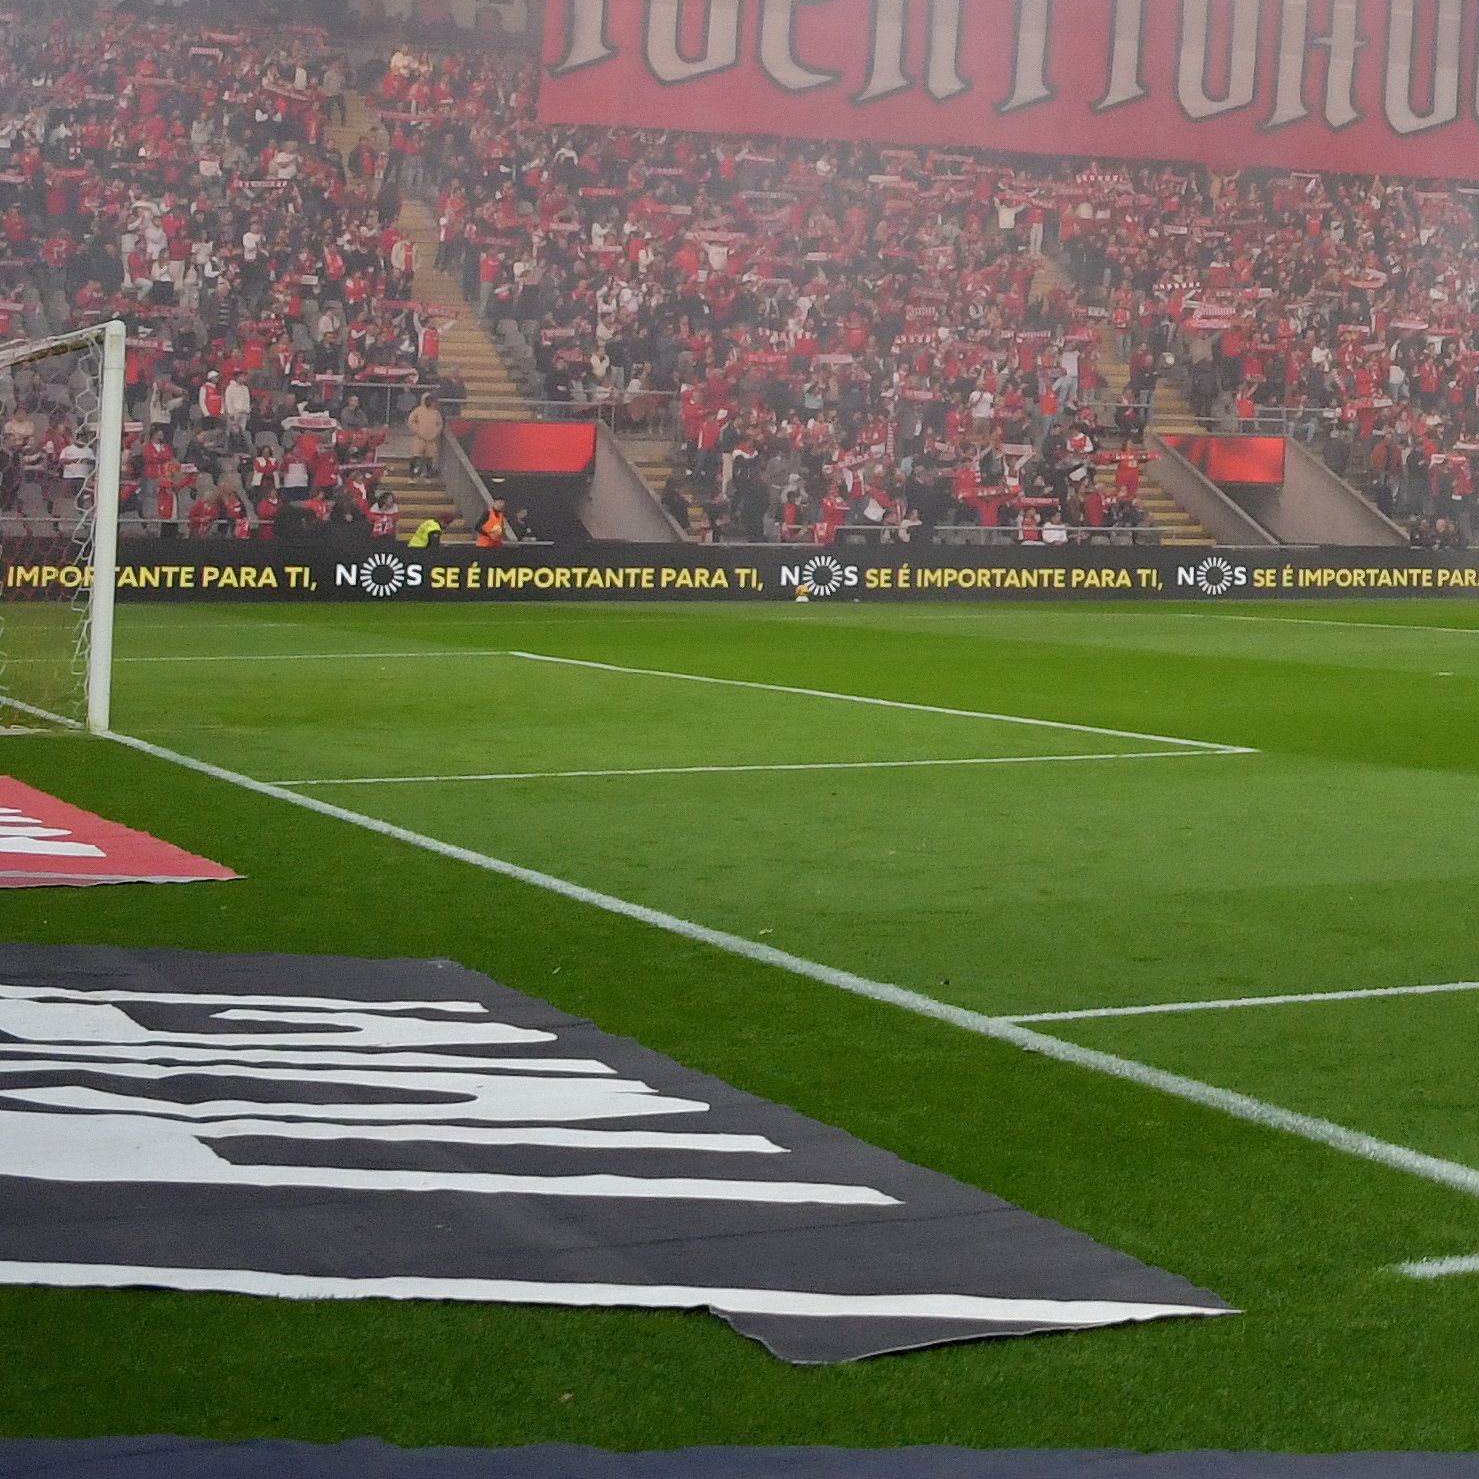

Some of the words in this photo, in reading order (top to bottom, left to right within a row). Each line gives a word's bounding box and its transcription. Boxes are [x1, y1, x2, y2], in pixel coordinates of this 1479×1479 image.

[202, 566, 278, 588] PARA
[285, 567, 318, 591] TI,
[431, 567, 459, 588] SE
[467, 562, 480, 588] É
[487, 567, 655, 588] IMPORTANTE
[660, 567, 729, 588] PARA
[735, 568, 764, 591] TI,
[865, 568, 892, 589] SE
[897, 563, 911, 589] É
[916, 568, 1066, 588] IMPORTANTE
[1071, 568, 1132, 588] PARA
[1137, 568, 1164, 591] TI,
[1253, 568, 1277, 587] SE
[1281, 564, 1294, 587] É
[1298, 568, 1433, 587] IMPORTANTE
